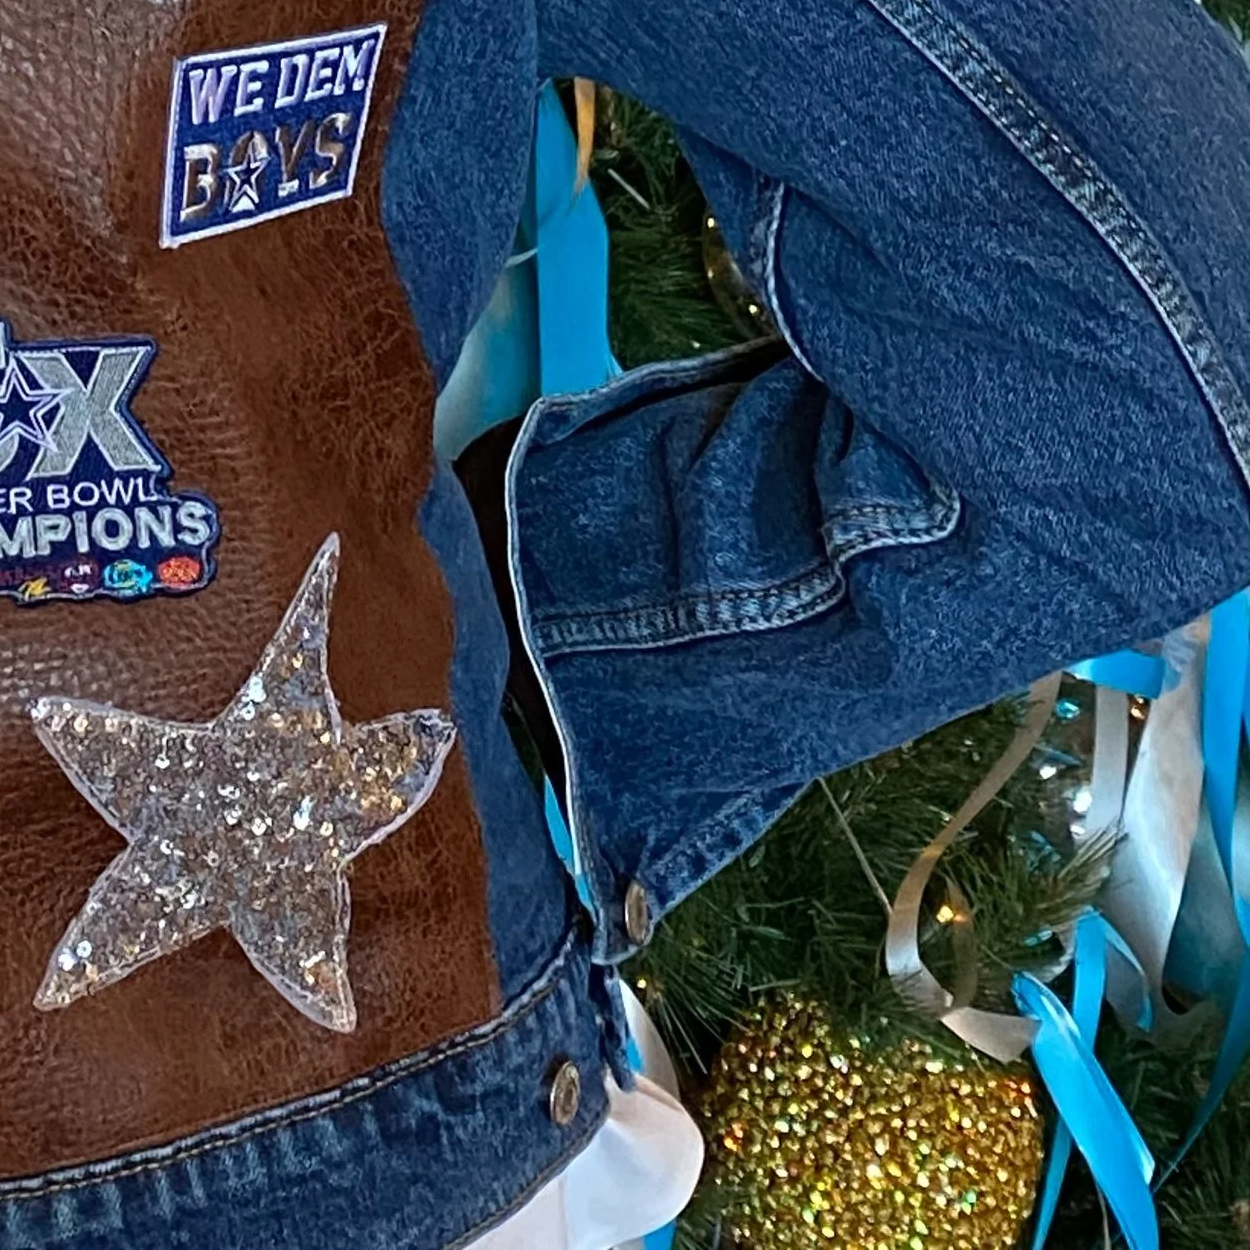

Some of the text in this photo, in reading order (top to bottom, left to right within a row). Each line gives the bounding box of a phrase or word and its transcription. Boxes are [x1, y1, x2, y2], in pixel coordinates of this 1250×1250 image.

[189, 39, 375, 125] WE DEM
[48, 480, 158, 509] BOWL
